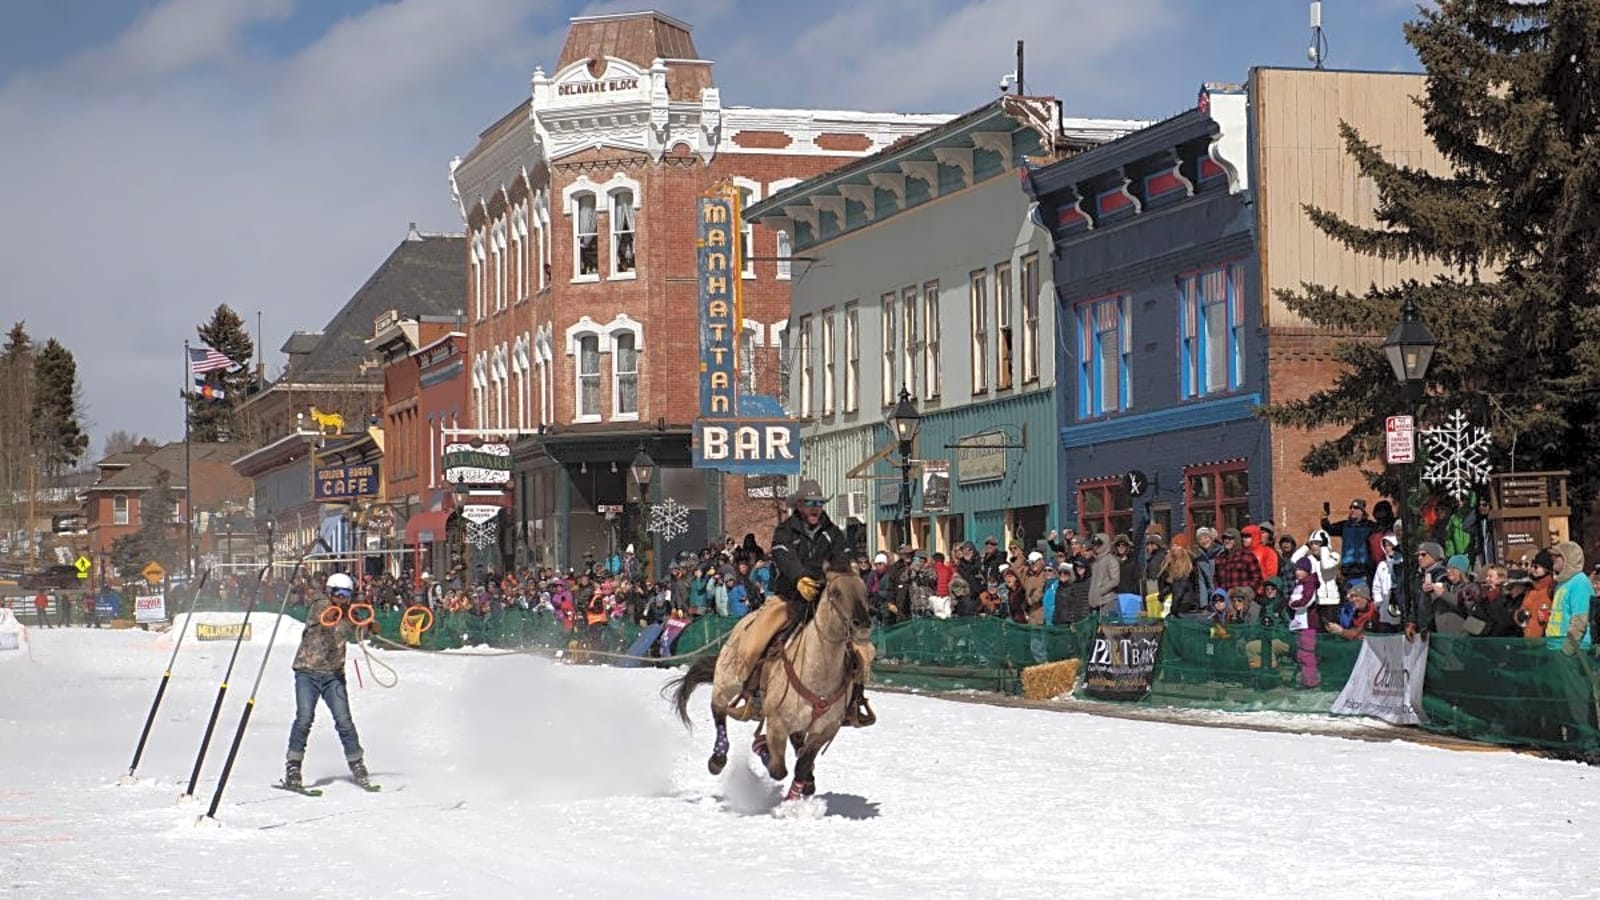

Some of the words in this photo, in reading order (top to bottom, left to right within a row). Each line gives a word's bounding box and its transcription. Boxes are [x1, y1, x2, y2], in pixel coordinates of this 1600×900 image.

[558, 82, 606, 96] DELAWARE
[608, 79, 639, 92] BLOCK
[704, 203, 729, 413] MANHATTAN
[702, 425, 795, 460] BAR
[444, 453, 512, 469] DELAWARE
[323, 478, 369, 495] CAFE
